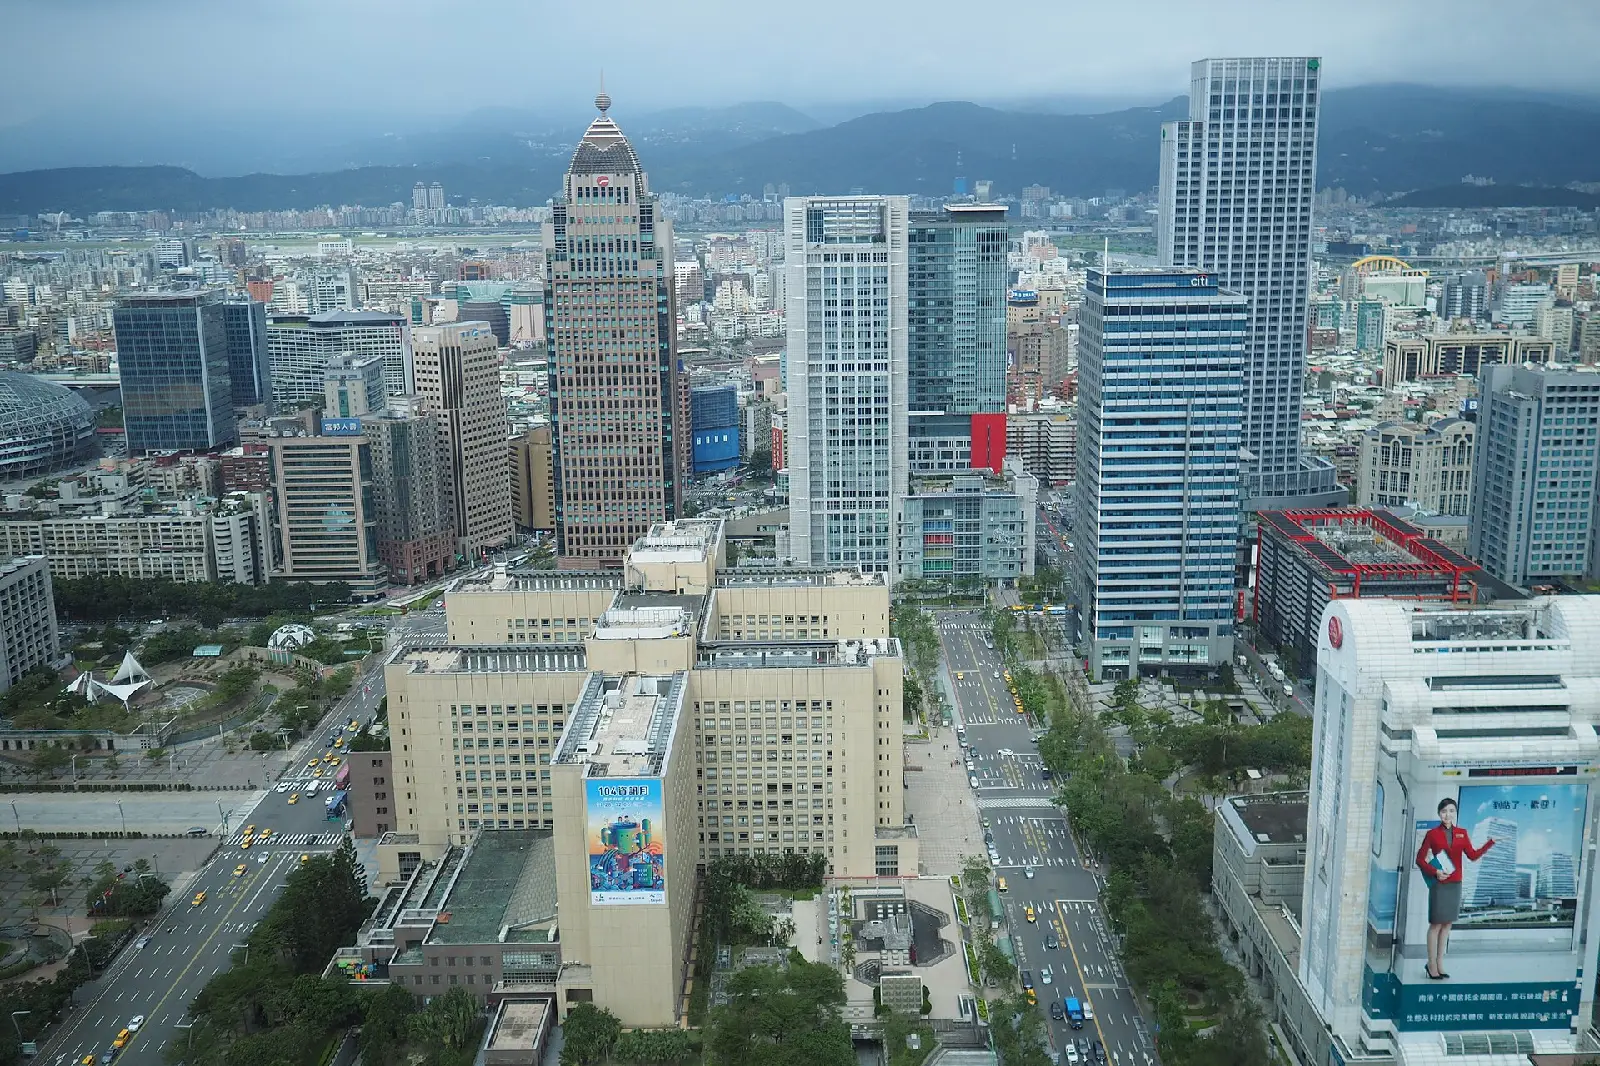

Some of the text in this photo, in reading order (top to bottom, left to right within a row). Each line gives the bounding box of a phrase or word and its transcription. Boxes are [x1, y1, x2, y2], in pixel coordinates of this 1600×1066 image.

[1191, 275, 1208, 287] citi
[598, 785, 649, 796] 104資訊月
